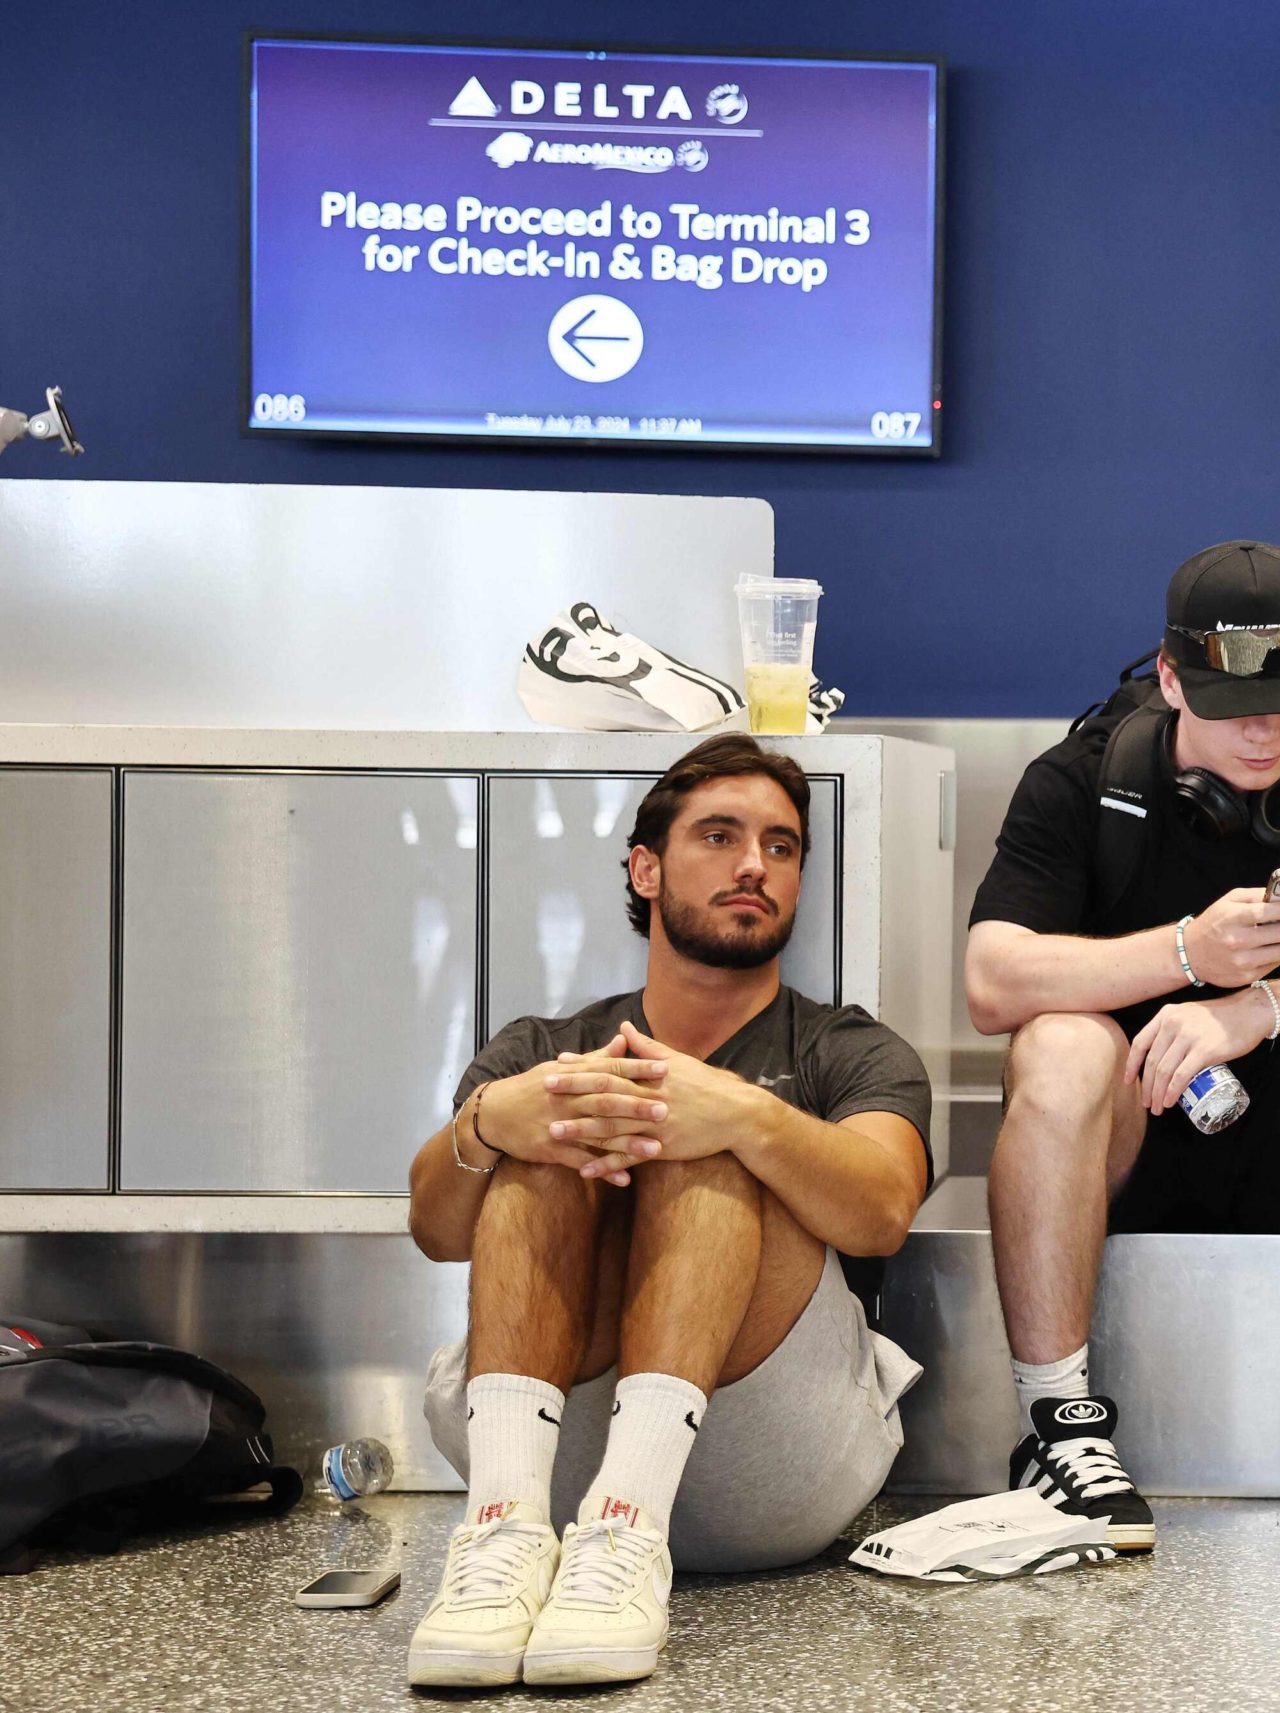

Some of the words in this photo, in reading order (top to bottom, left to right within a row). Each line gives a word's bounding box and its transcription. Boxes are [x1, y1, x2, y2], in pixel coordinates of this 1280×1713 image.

[511, 80, 693, 121] DELTA
[321, 191, 448, 232] Please
[456, 195, 612, 238] Proceed
[619, 203, 662, 240] to
[668, 203, 836, 245] Terminal
[844, 208, 871, 246] 3
[361, 234, 421, 273] for
[427, 236, 600, 279] Check-In
[608, 242, 644, 281] &
[651, 244, 724, 290] Bag
[731, 246, 828, 293] Drop
[870, 410, 922, 439] 087
